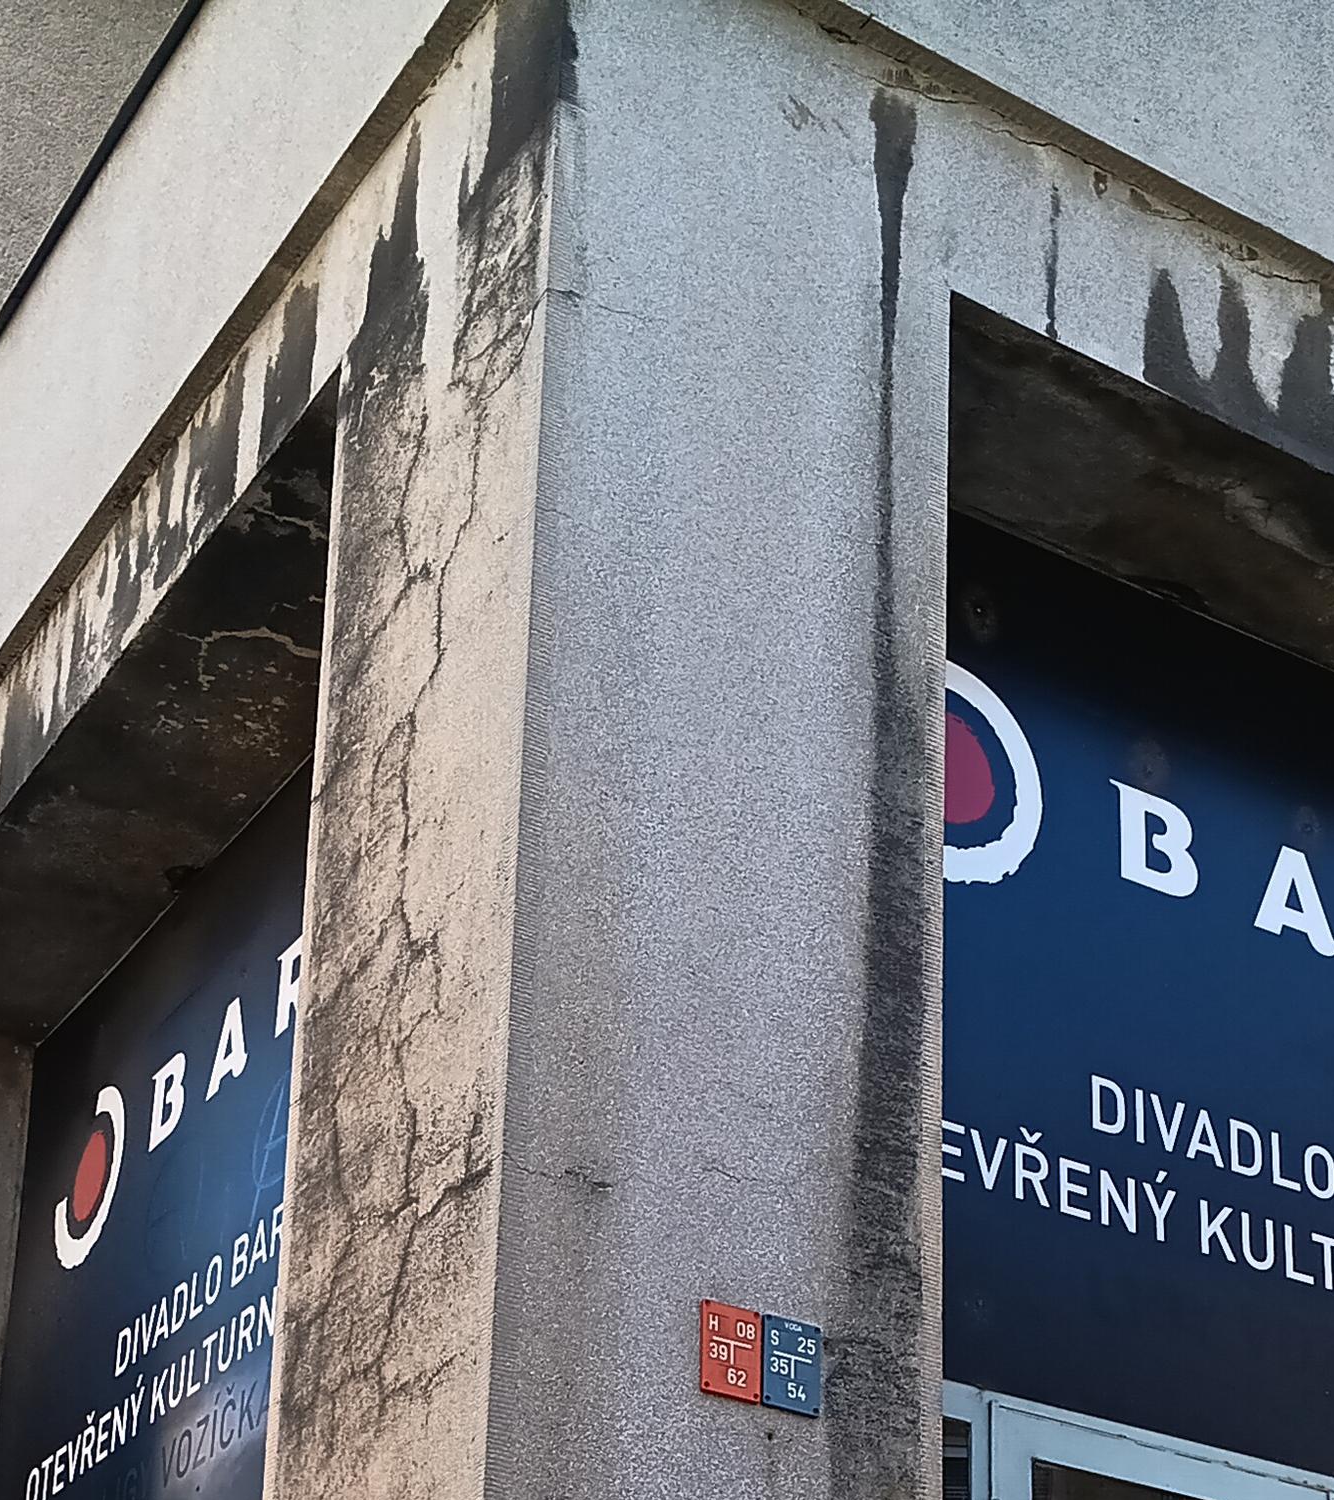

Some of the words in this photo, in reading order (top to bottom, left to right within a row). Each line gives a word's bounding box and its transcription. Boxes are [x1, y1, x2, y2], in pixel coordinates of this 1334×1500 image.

[941, 1118, 1177, 1242] EVŘENÝ
[115, 1254, 223, 1378] DIVADLO
[708, 1314, 719, 1332] H
[736, 1321, 756, 1341] 08
[148, 1286, 278, 1425] KULTURN
[709, 1342, 728, 1362] 39
[770, 1329, 780, 1346] S
[797, 1336, 816, 1356] 25
[727, 1368, 747, 1388] 62
[770, 1356, 789, 1375] 35
[787, 1382, 807, 1402] 54
